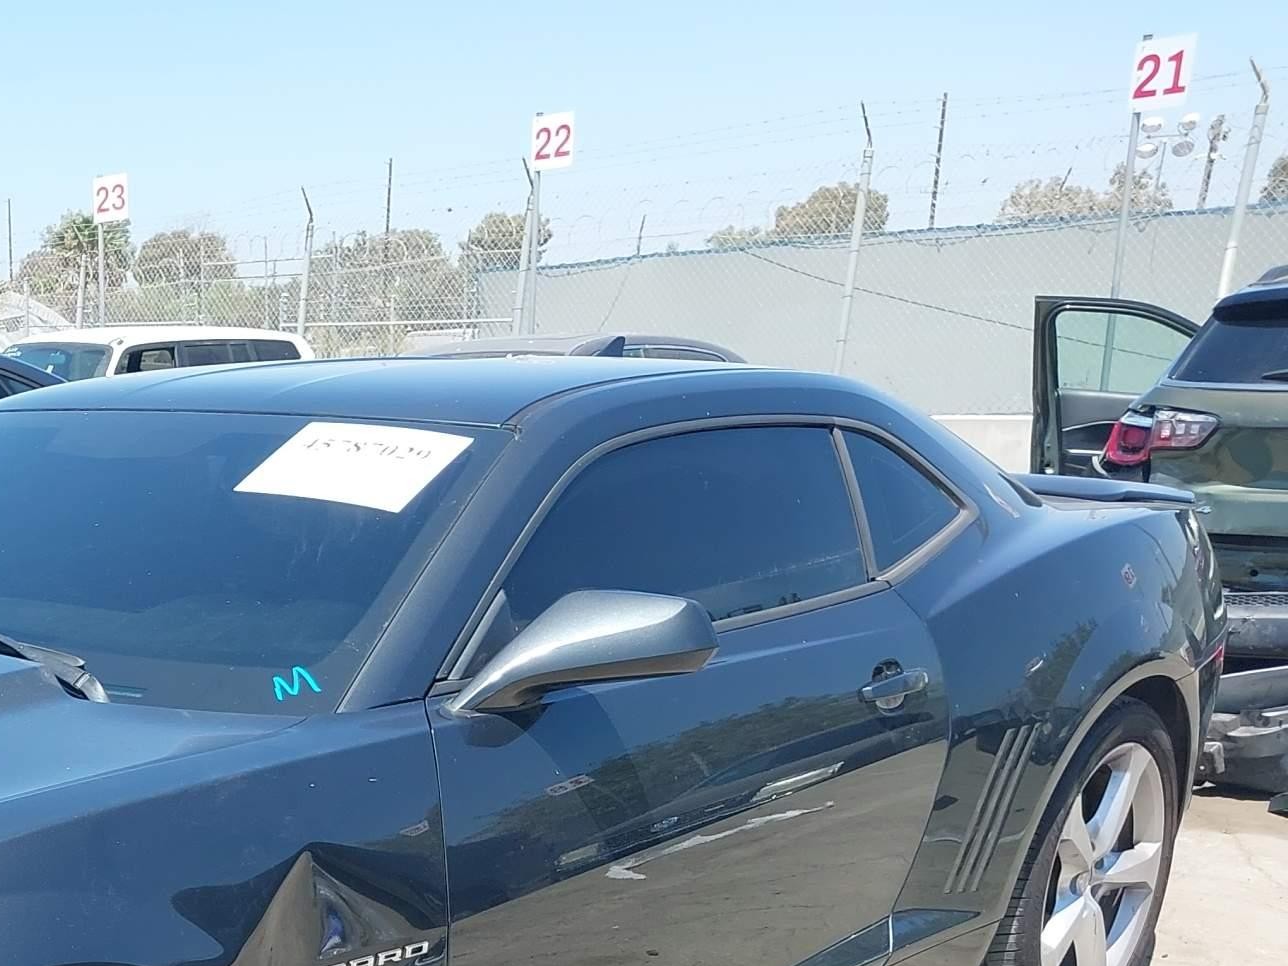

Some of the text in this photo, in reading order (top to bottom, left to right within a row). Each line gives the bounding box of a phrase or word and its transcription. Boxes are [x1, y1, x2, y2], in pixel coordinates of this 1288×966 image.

[1132, 49, 1186, 99] 21
[535, 124, 571, 161] 22
[96, 184, 125, 214] 23
[272, 666, 322, 701] M
